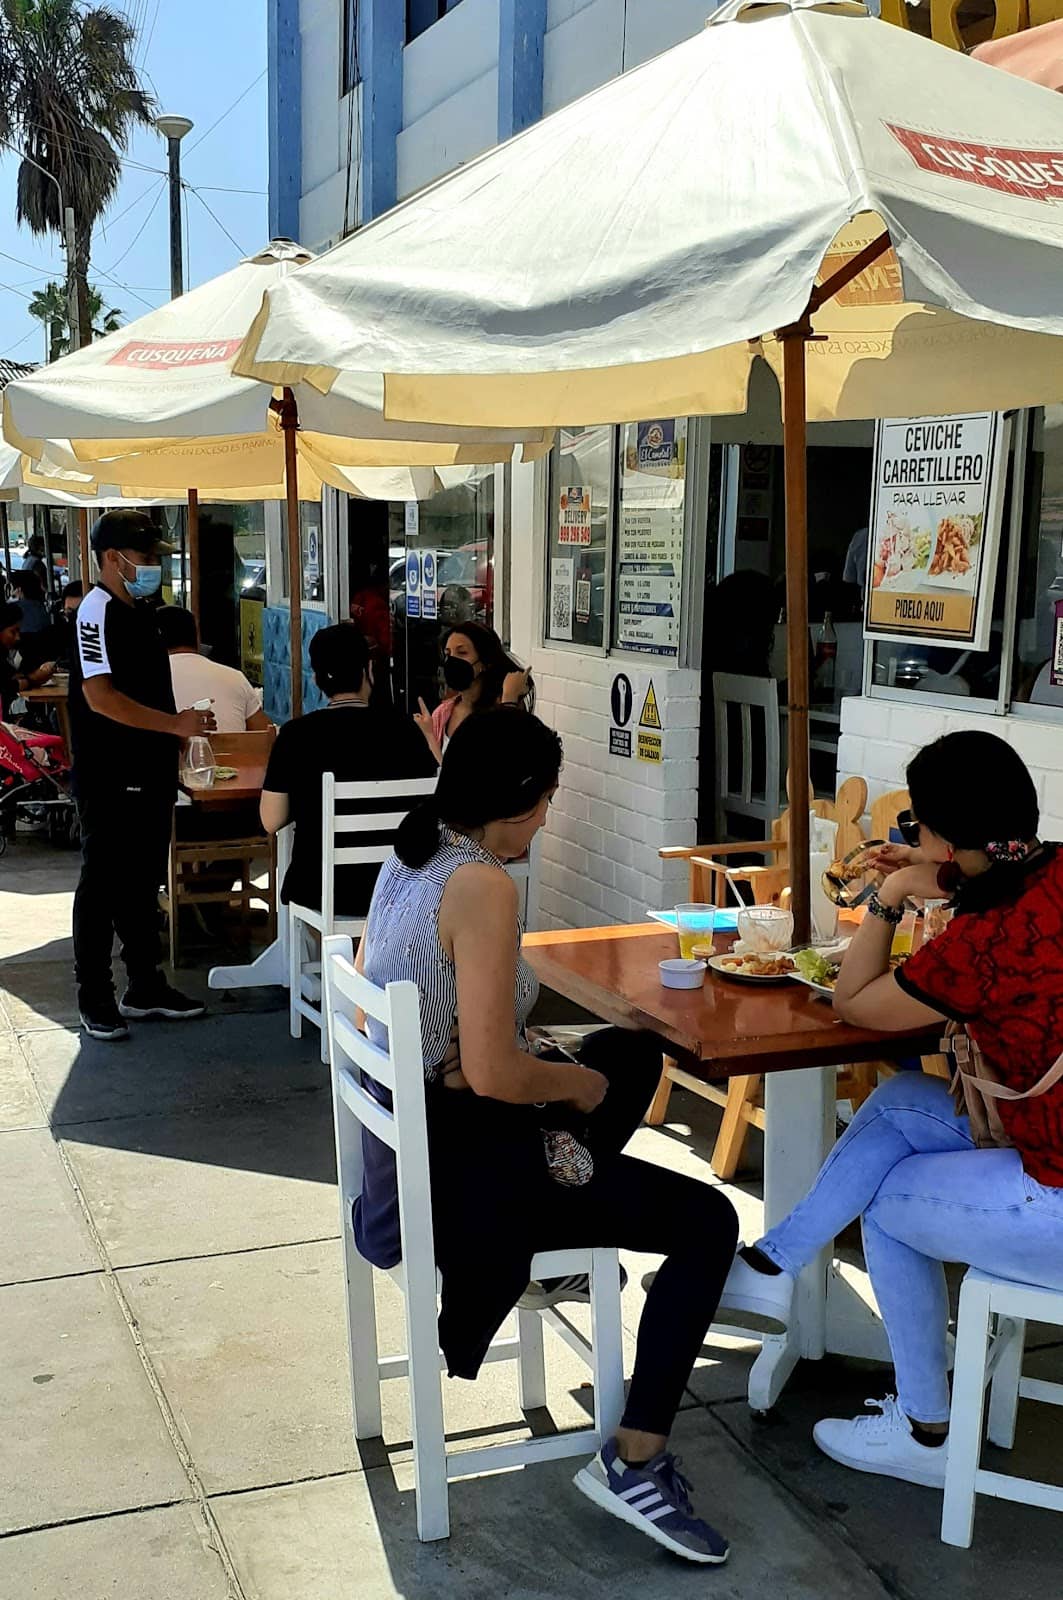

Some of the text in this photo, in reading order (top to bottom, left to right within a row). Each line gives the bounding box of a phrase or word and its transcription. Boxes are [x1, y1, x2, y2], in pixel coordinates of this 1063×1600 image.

[920, 143, 1063, 189] CUSQUE
[127, 345, 227, 364] CUSQUEÑA
[905, 424, 963, 452] CEVICHE
[883, 454, 983, 484] CARRETILLERO
[893, 490, 966, 506] PARA LLEVAR
[564, 510, 588, 524] DELIVERY
[895, 599, 945, 622] PIDELO AQUI
[80, 621, 103, 664] NIKE
